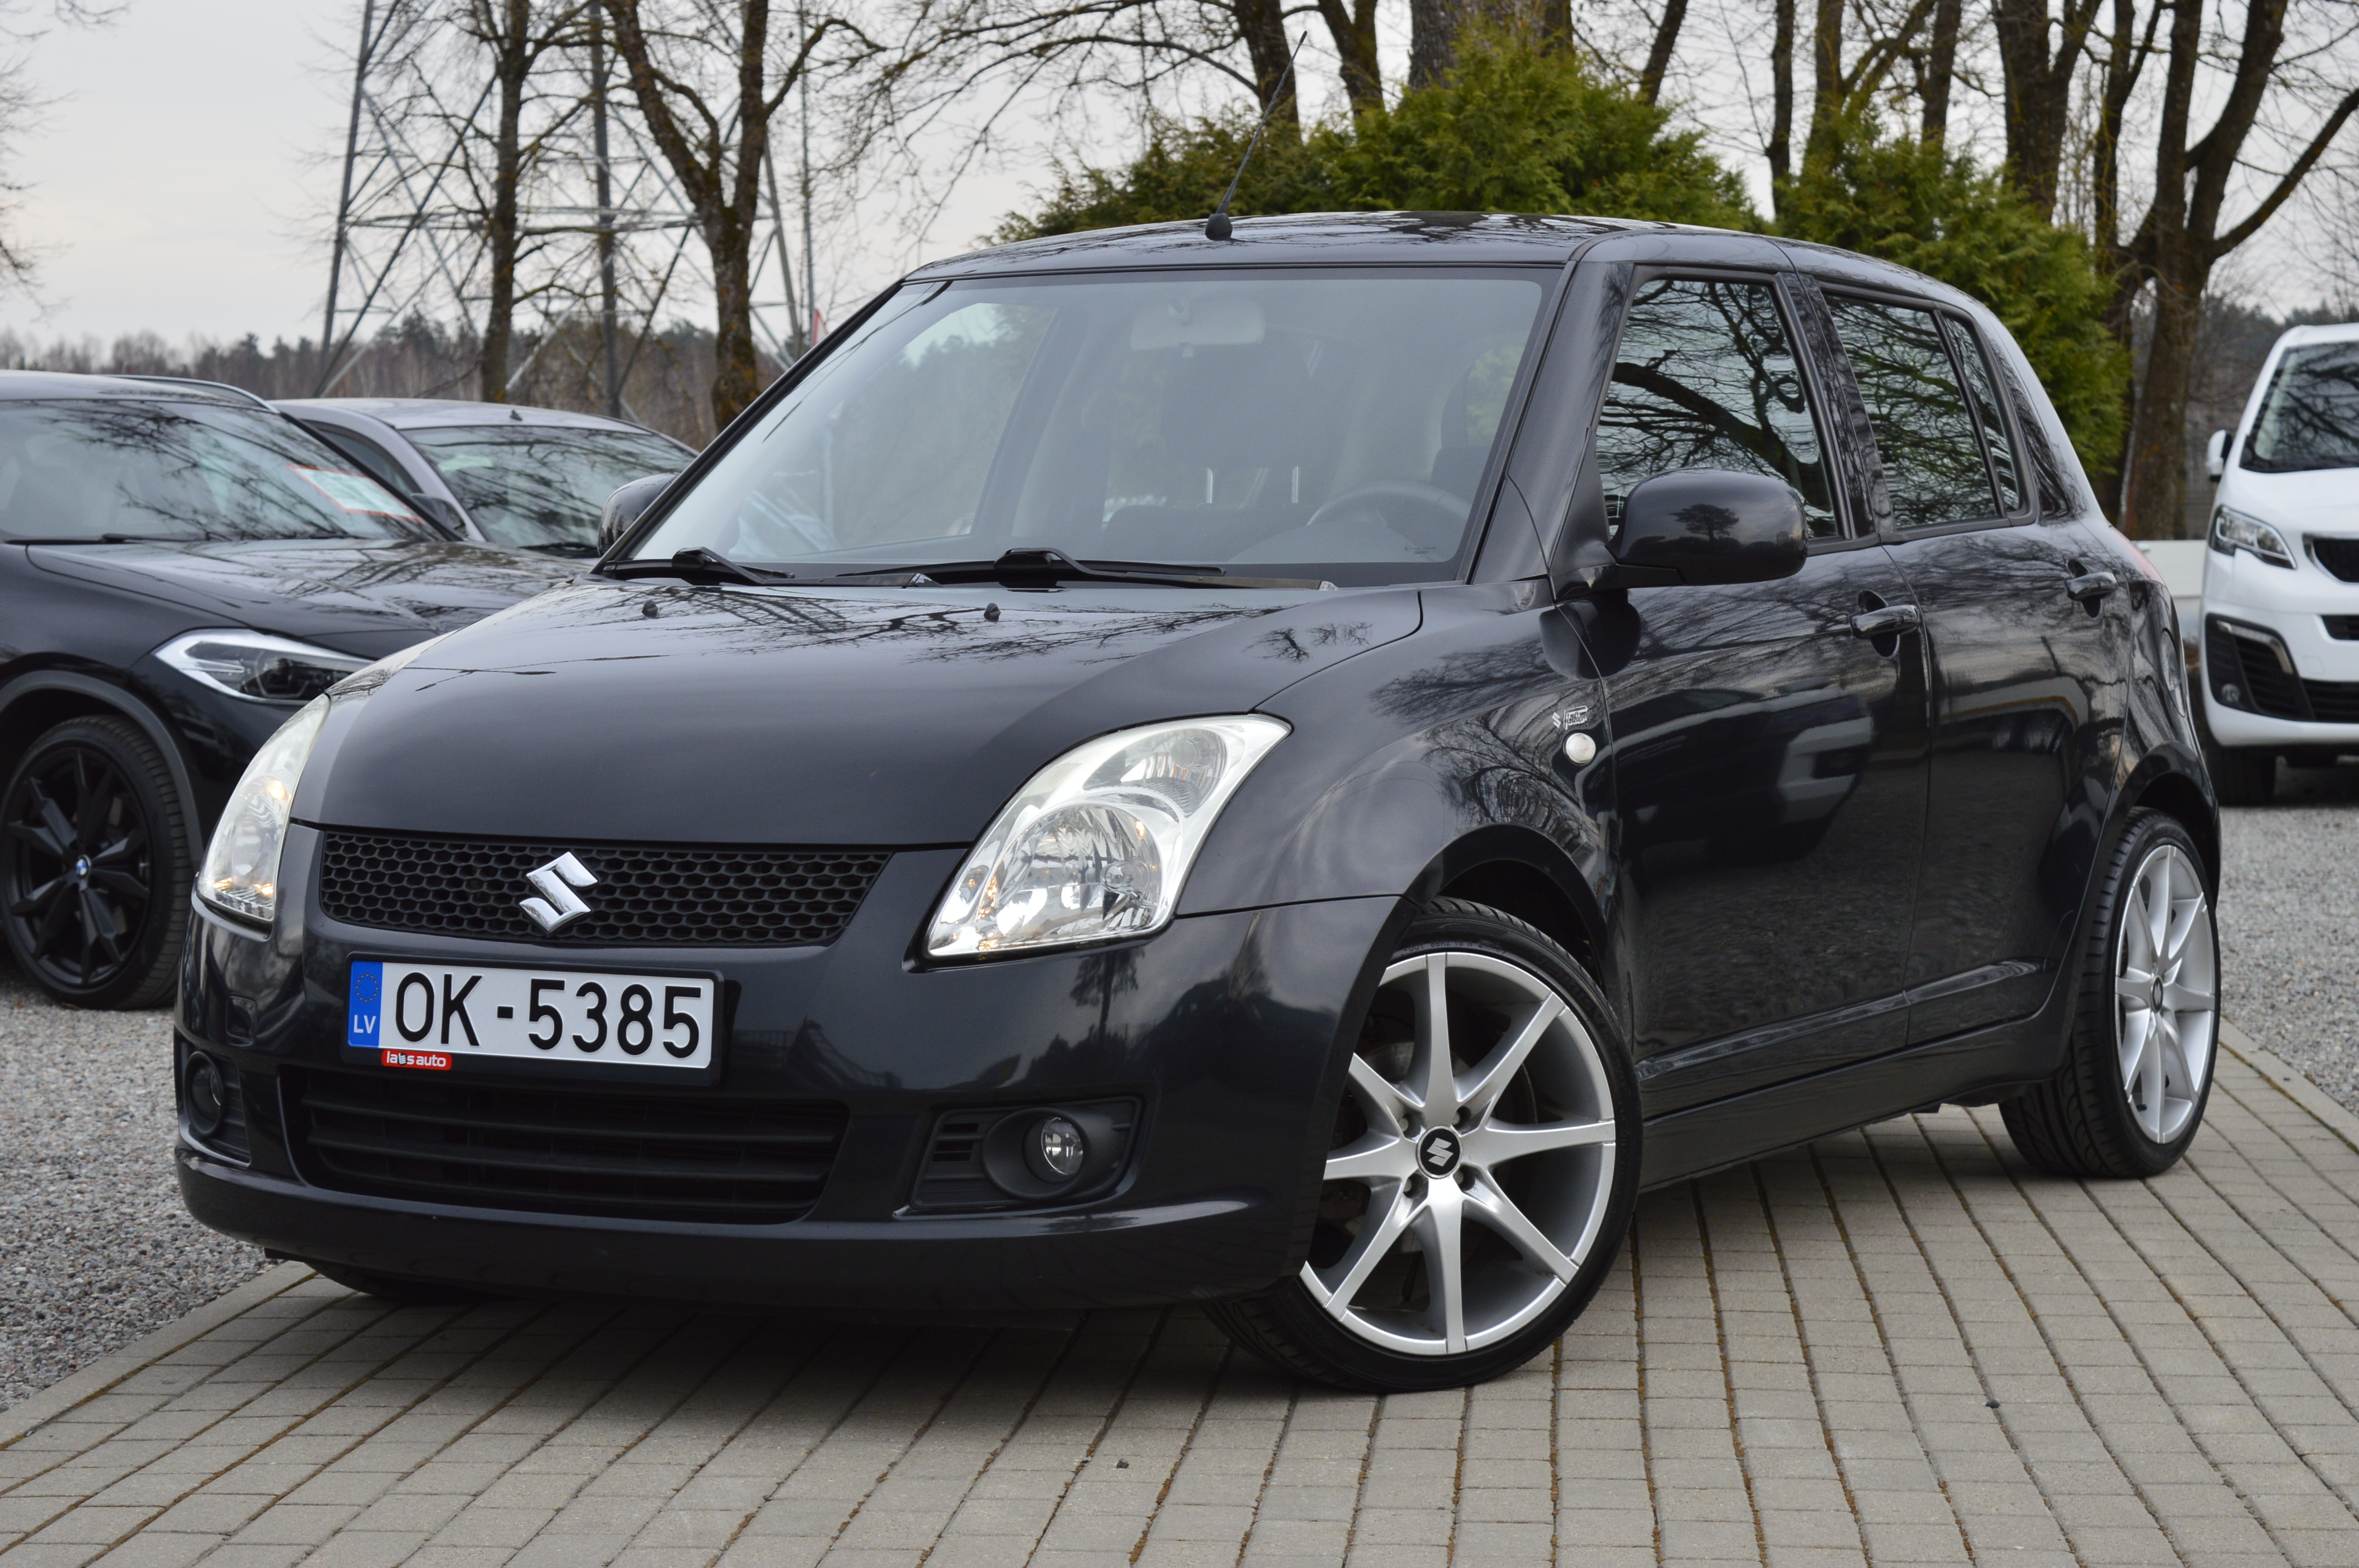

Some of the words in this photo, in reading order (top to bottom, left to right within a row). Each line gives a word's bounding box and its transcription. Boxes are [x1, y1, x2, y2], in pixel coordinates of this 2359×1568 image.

[353, 1014, 376, 1034] LV
[395, 972, 702, 1058] OK-5385
[416, 1054, 446, 1067] auto
